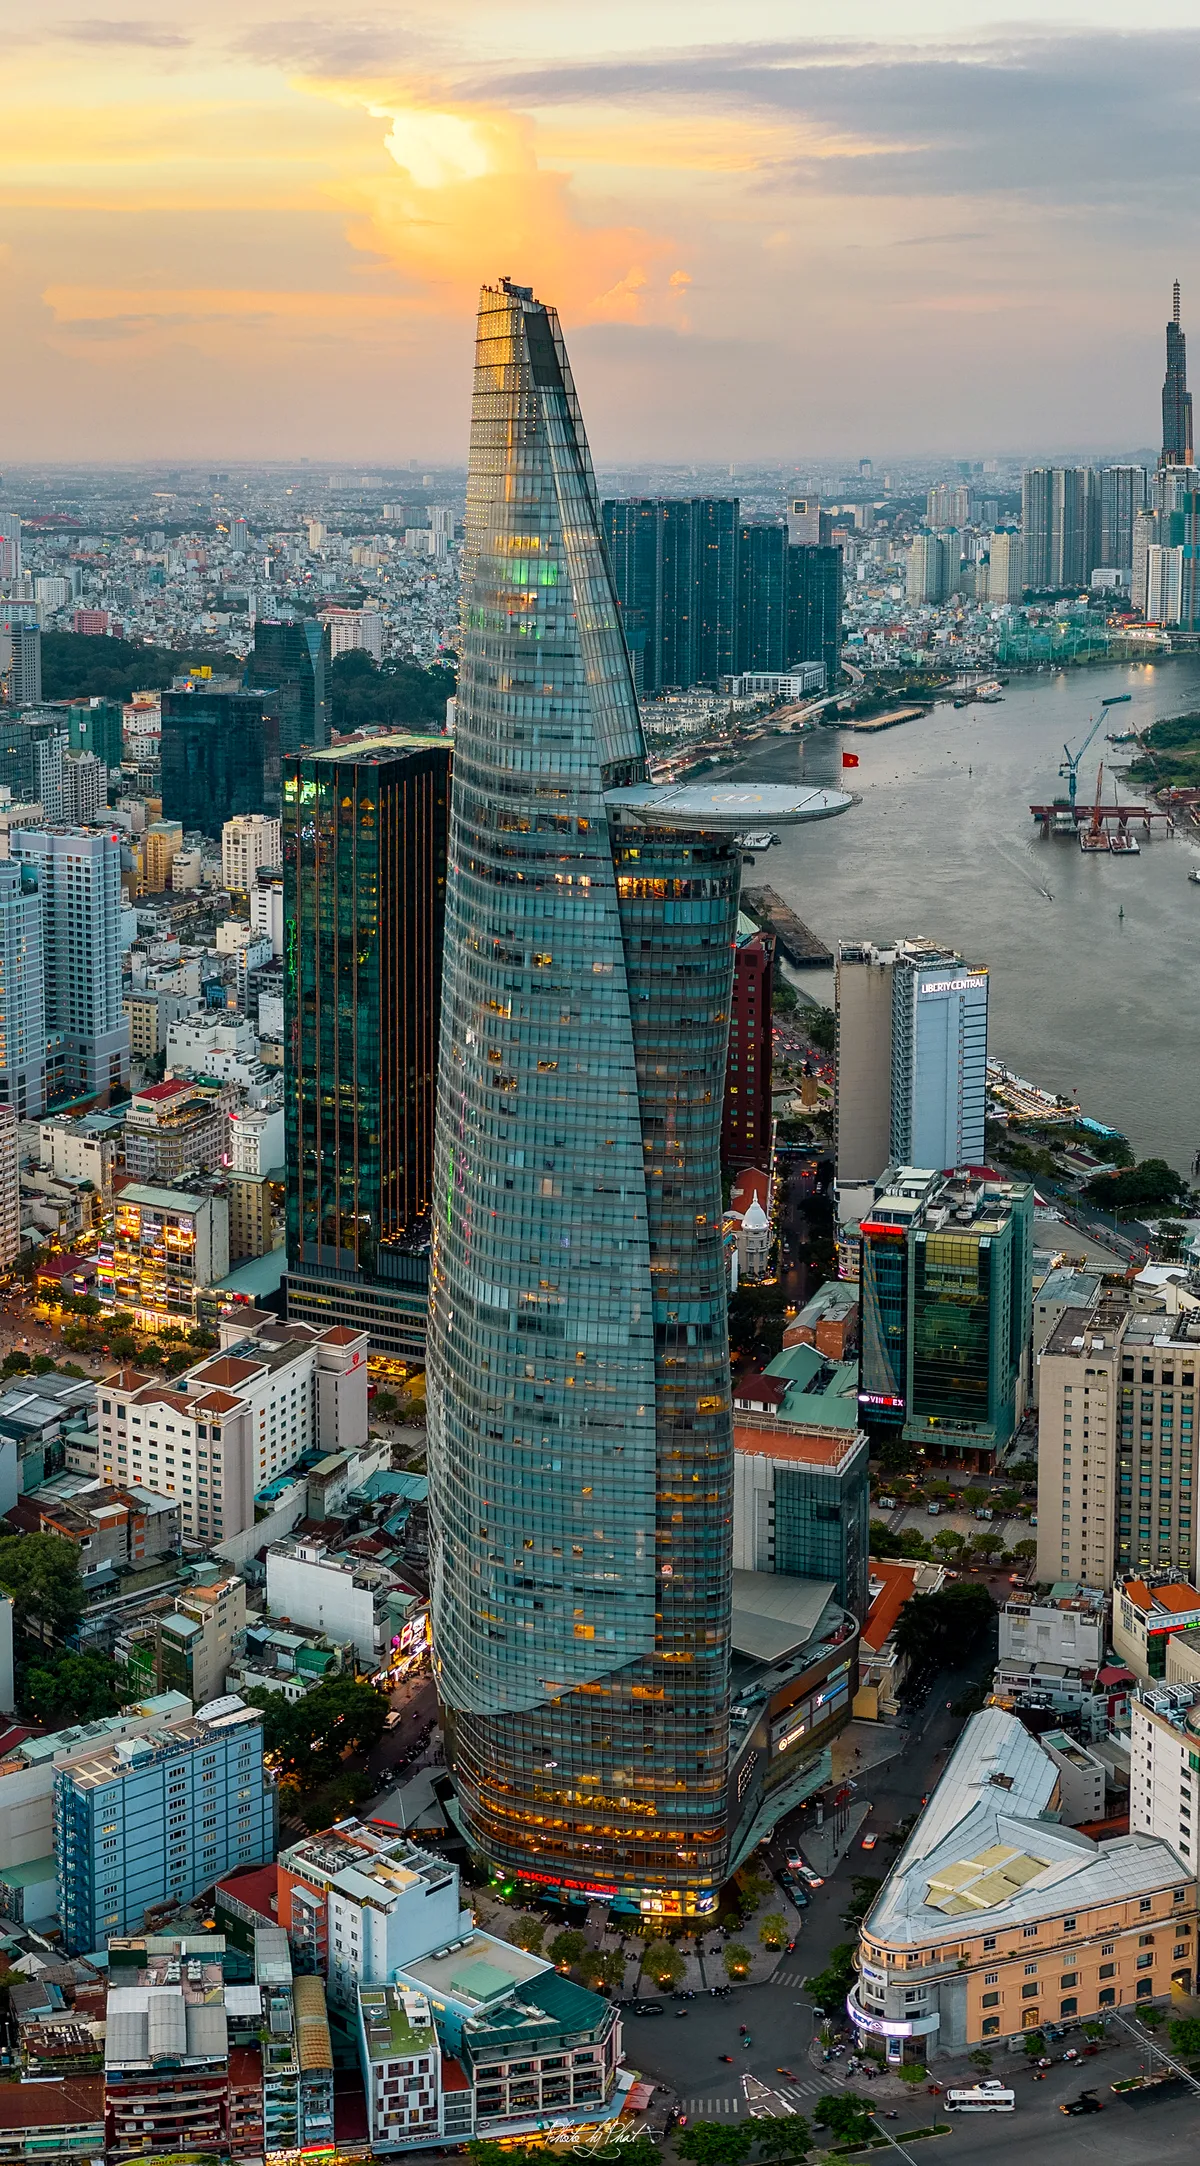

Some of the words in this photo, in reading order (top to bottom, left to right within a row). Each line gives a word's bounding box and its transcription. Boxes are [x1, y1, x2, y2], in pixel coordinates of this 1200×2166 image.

[921, 981, 951, 994] LIBERTY
[951, 978, 985, 990] CENTRAL
[517, 1868, 562, 1888] SAIGON
[564, 1878, 620, 1895] SKYDECK
